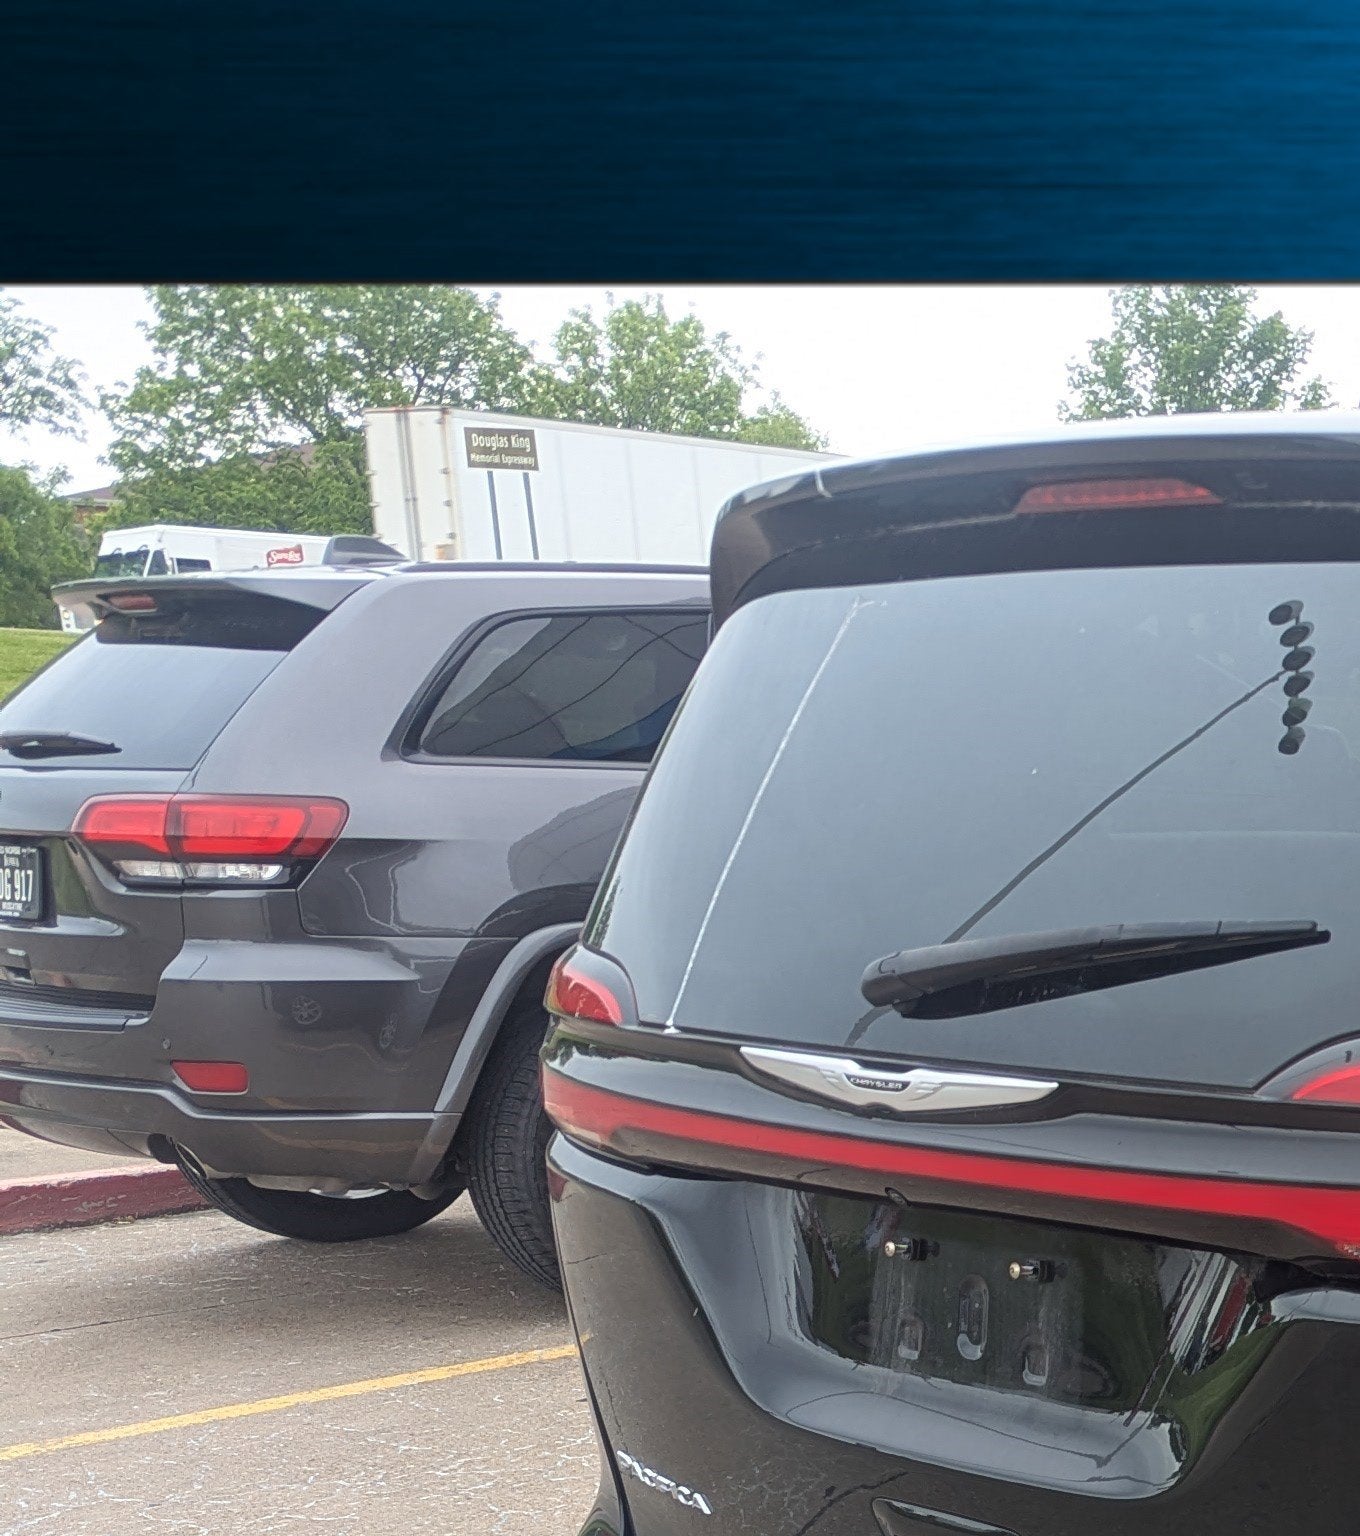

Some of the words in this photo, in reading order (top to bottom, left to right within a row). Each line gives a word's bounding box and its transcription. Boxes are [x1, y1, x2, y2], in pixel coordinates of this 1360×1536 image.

[471, 433, 509, 451] Douglas
[510, 433, 531, 452] King
[470, 452, 500, 463] Memorial
[501, 453, 535, 467] Expressway
[14, 868, 33, 902] 917
[850, 1076, 903, 1090] CHRYSLER
